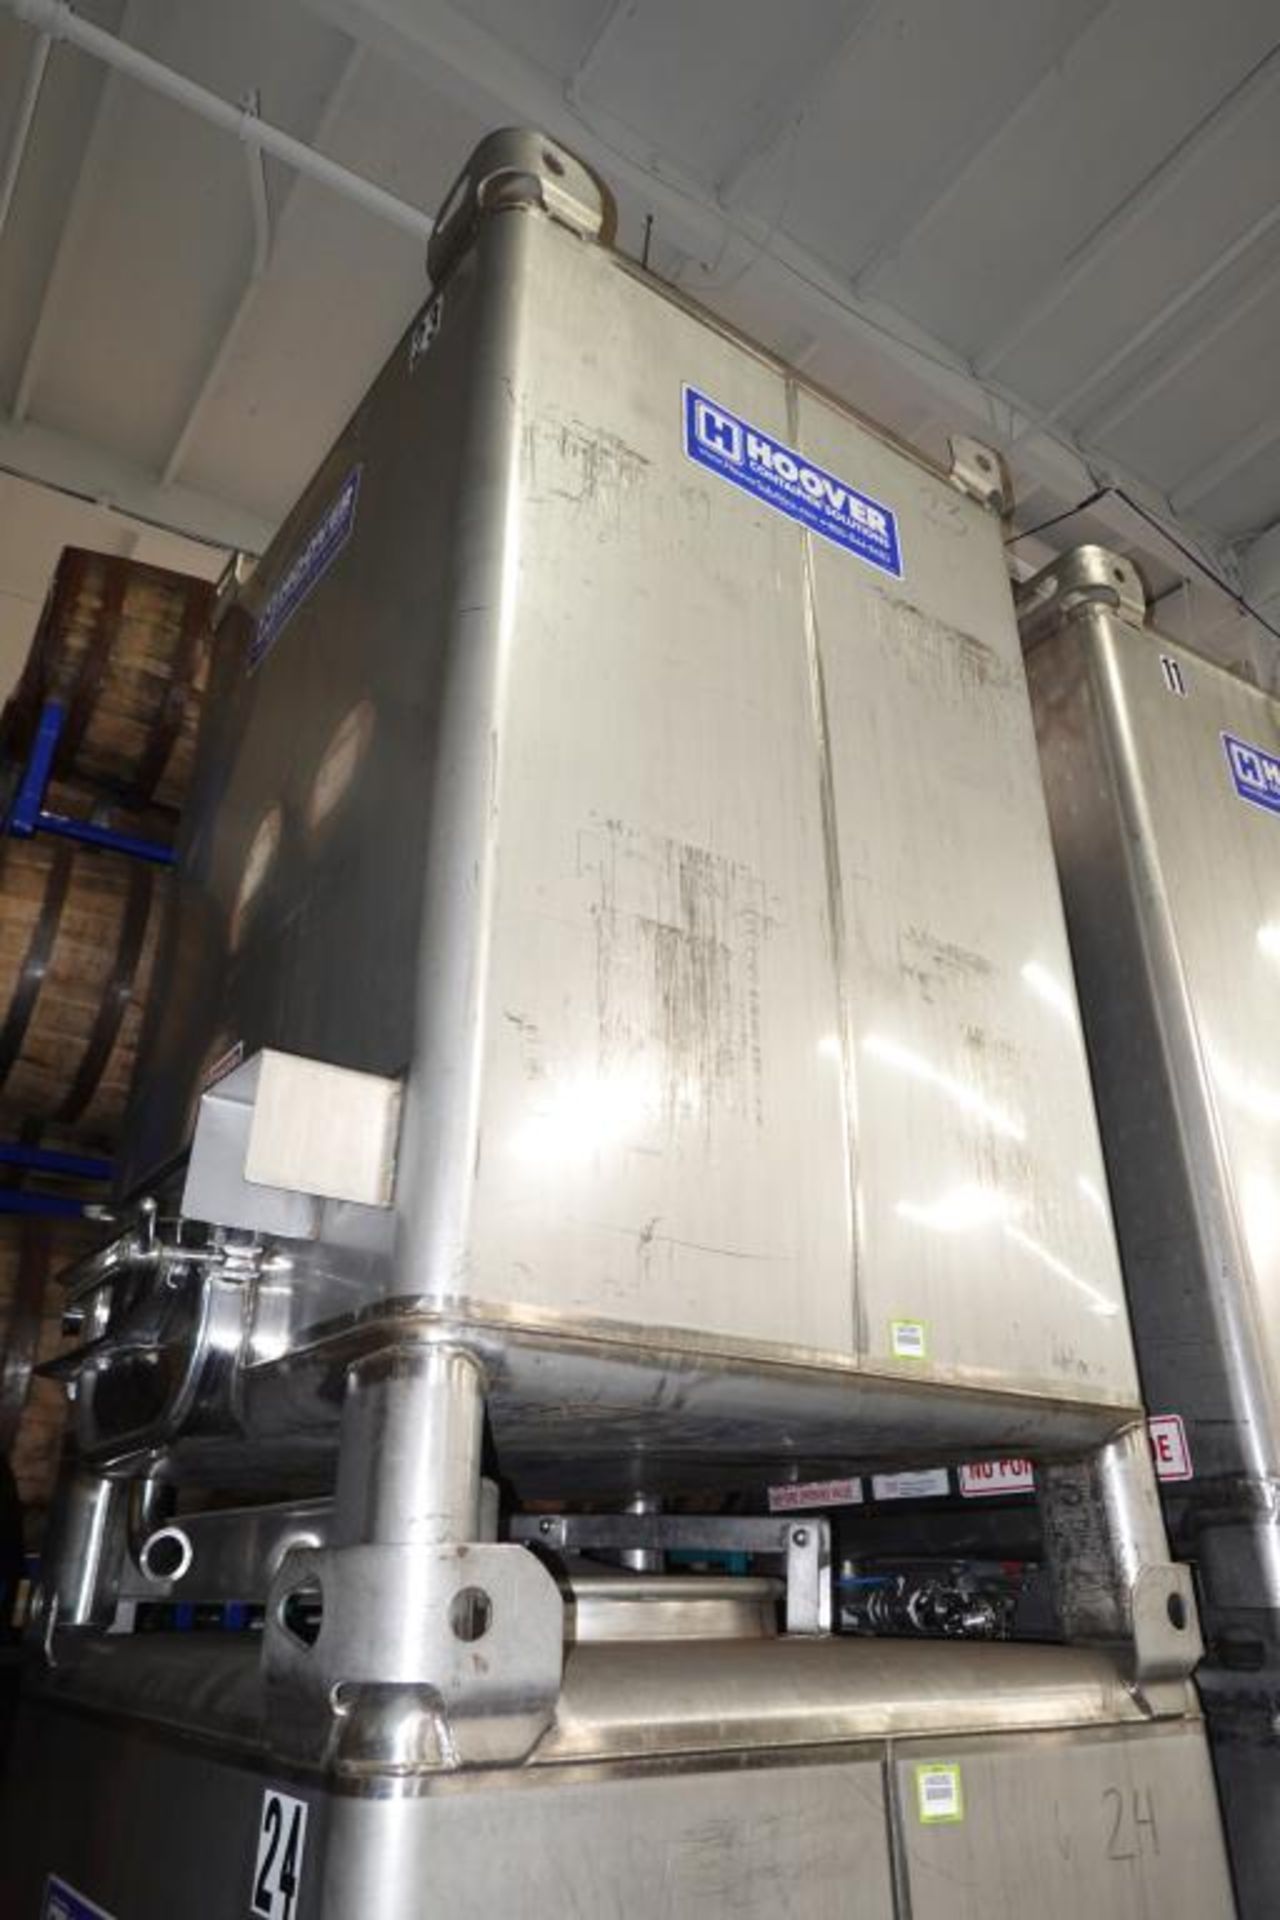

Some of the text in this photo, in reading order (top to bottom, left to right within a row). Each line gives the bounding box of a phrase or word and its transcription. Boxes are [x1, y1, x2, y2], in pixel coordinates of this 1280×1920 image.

[746, 433, 888, 536] HOOVER
[1161, 657, 1186, 697] 11
[254, 1797, 302, 1920] 24
[1103, 1786, 1160, 1861] 24
